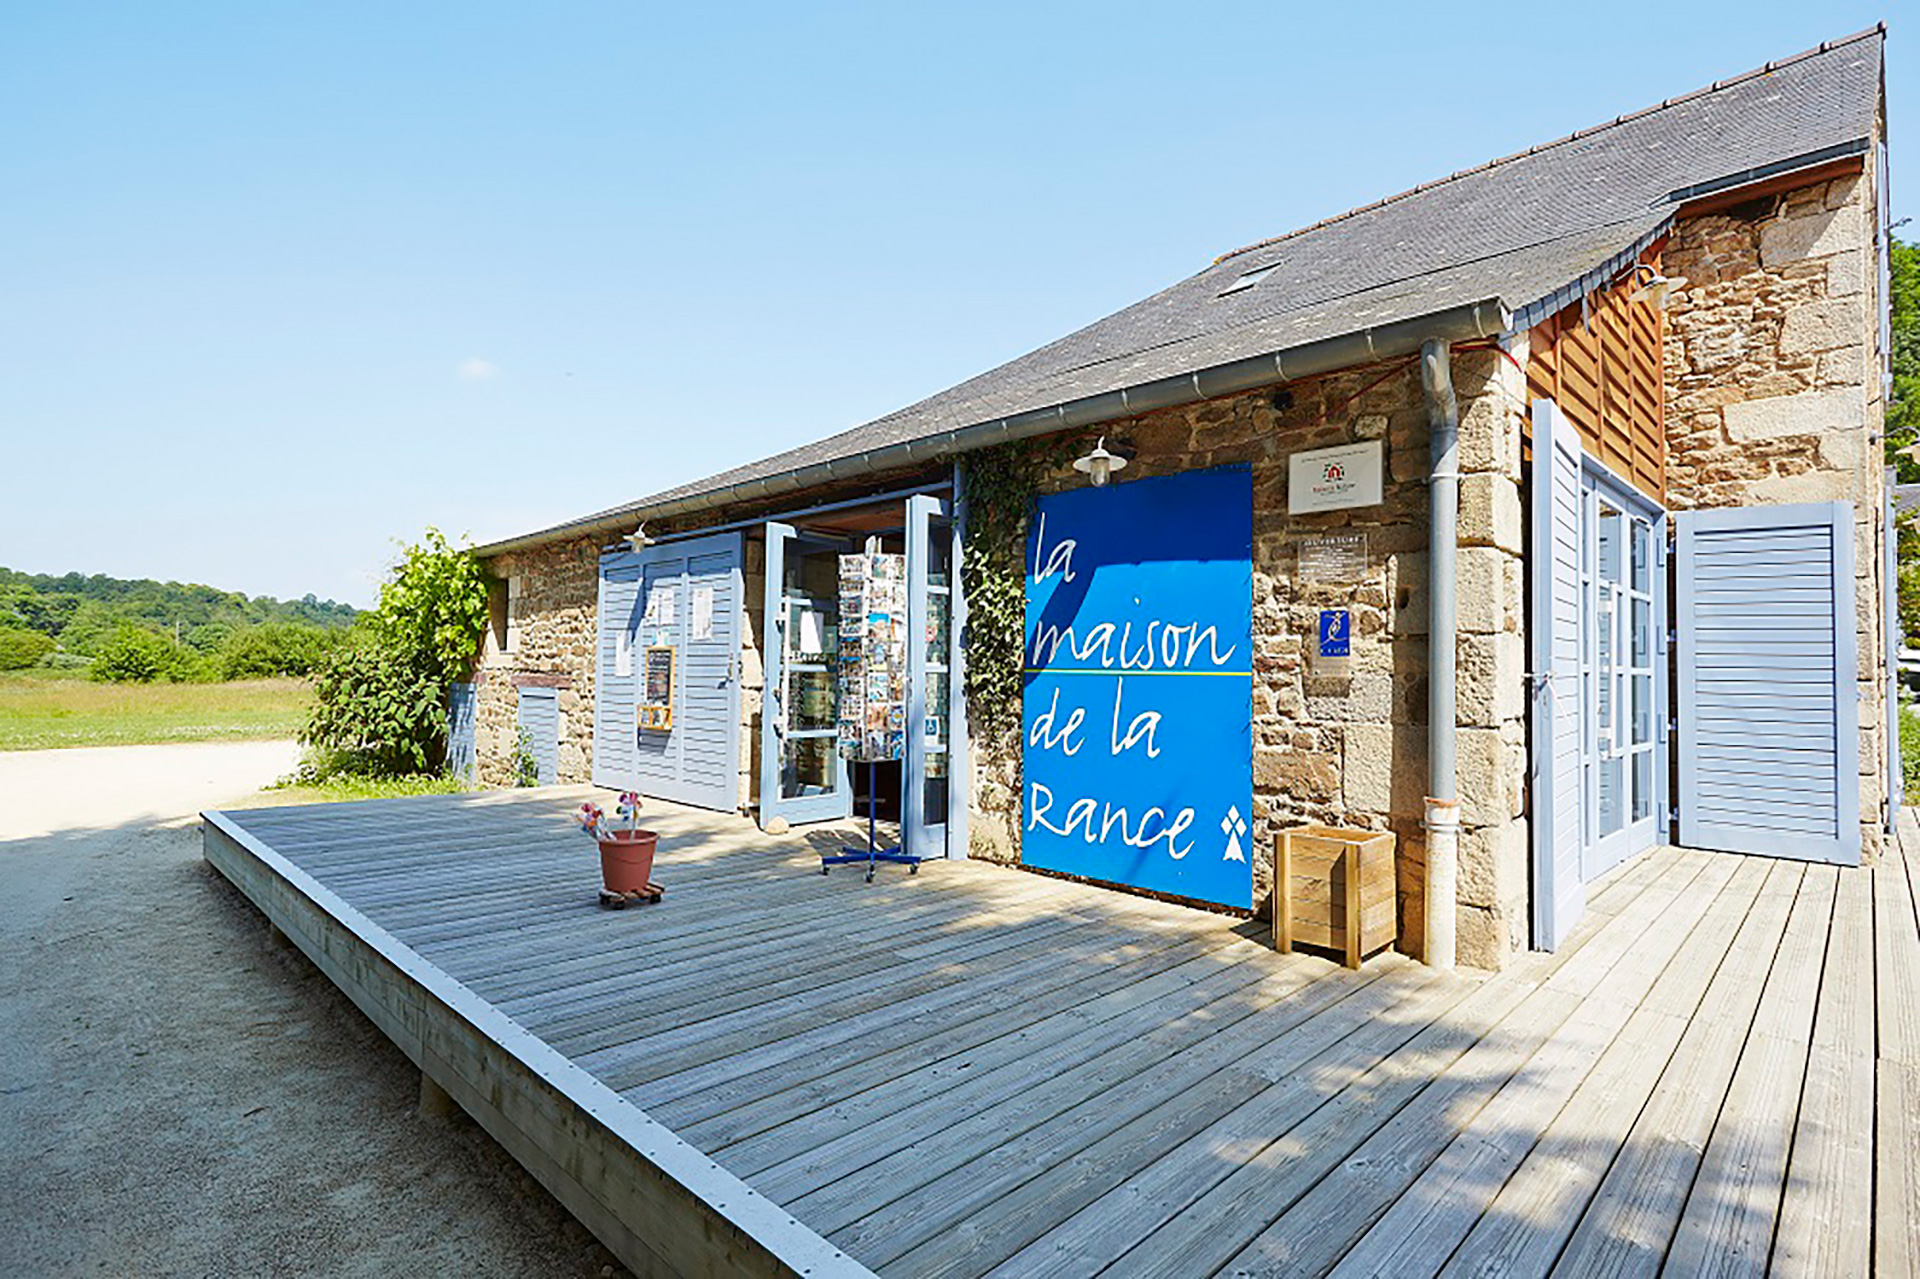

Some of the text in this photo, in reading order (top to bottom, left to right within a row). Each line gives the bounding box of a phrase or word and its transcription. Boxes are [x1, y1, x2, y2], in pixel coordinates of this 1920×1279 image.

[1033, 511, 1077, 584] la
[1032, 597, 1237, 671] maison
[1029, 676, 1163, 758] de la
[1028, 781, 1196, 860] Rance
